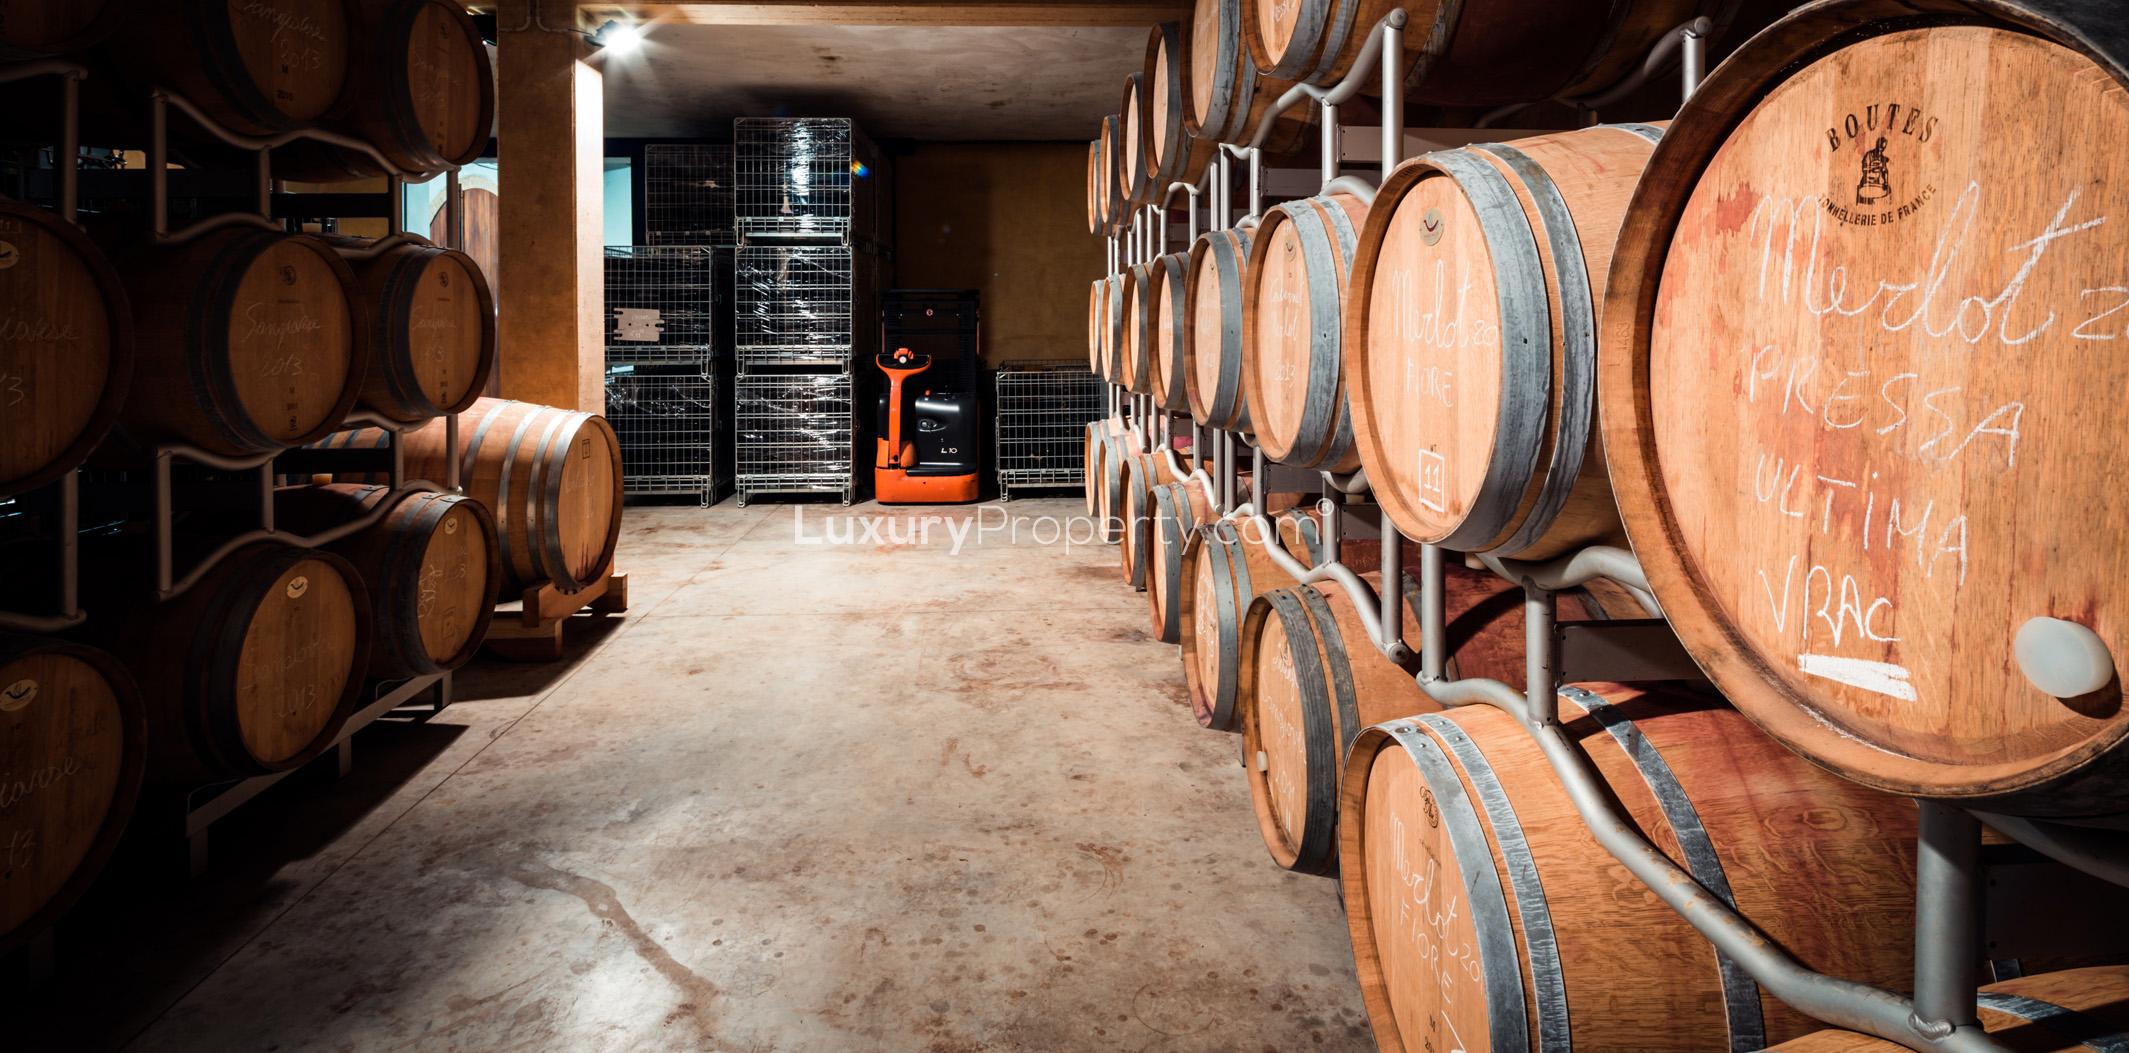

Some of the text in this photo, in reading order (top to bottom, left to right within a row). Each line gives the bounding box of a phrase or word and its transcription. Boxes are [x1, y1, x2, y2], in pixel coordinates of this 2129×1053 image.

[1825, 103, 1939, 152] BOUTES
[1880, 211, 1894, 225] DE
[1897, 184, 1937, 220] FRANCE
[1391, 259, 1473, 348] Merlot
[1751, 180, 2129, 345] Merlot 2
[1749, 344, 2024, 467] PRESSA
[1422, 462, 1441, 495] 11
[1758, 554, 1901, 647] VRAC
[1390, 811, 1458, 957] Merlot
[1400, 896, 1453, 1005] FIORE
